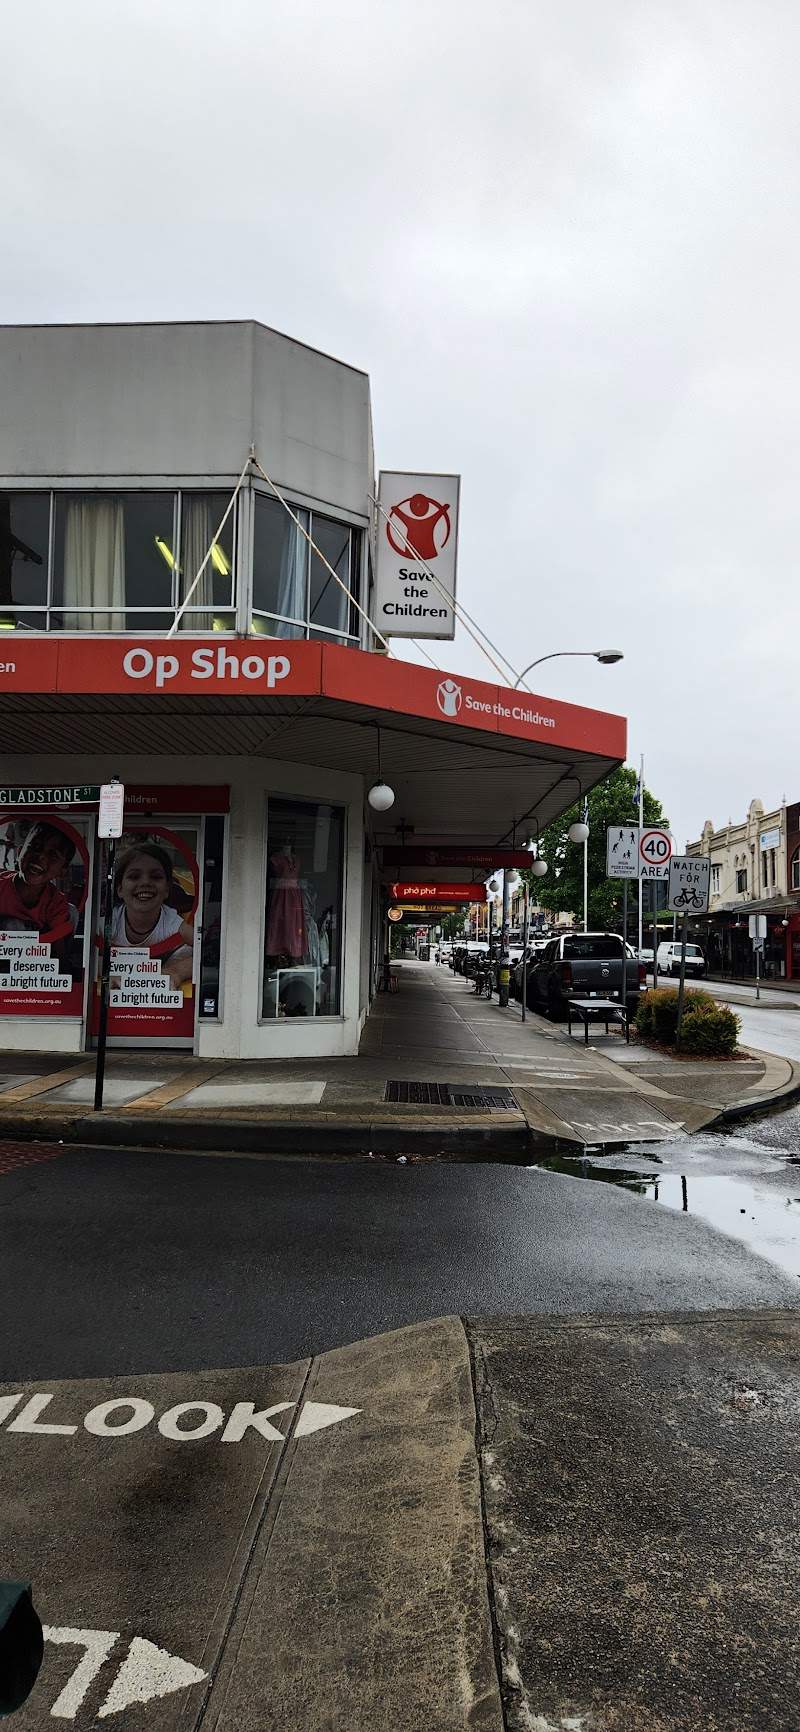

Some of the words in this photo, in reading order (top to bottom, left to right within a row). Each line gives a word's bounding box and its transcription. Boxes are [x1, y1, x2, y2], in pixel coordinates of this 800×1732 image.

[398, 568, 434, 582] Save
[404, 585, 428, 598] the
[382, 602, 448, 618] Children
[122, 648, 180, 688] Op
[190, 647, 291, 688] Shop
[465, 695, 492, 714] Save
[493, 703, 511, 718] the
[512, 707, 555, 728] Children
[0, 788, 81, 803] GLADSTONE
[83, 788, 92, 796] ST
[125, 794, 158, 804] hildren
[645, 839, 667, 857] 40
[641, 866, 670, 877] AREA
[673, 862, 708, 871] WATCH
[680, 874, 700, 883] FOR
[0, 945, 23, 958] Every
[25, 945, 47, 956] child
[14, 961, 55, 972] deserves
[109, 961, 134, 975] Every
[136, 961, 158, 973] child
[1, 978, 7, 986] a
[10, 976, 37, 989] bright
[40, 976, 69, 987] future
[124, 977, 166, 988] deserves
[112, 994, 118, 1003] a
[121, 992, 149, 1006] bright
[151, 992, 179, 1004] future
[6, 1393, 298, 1442] LOOK
